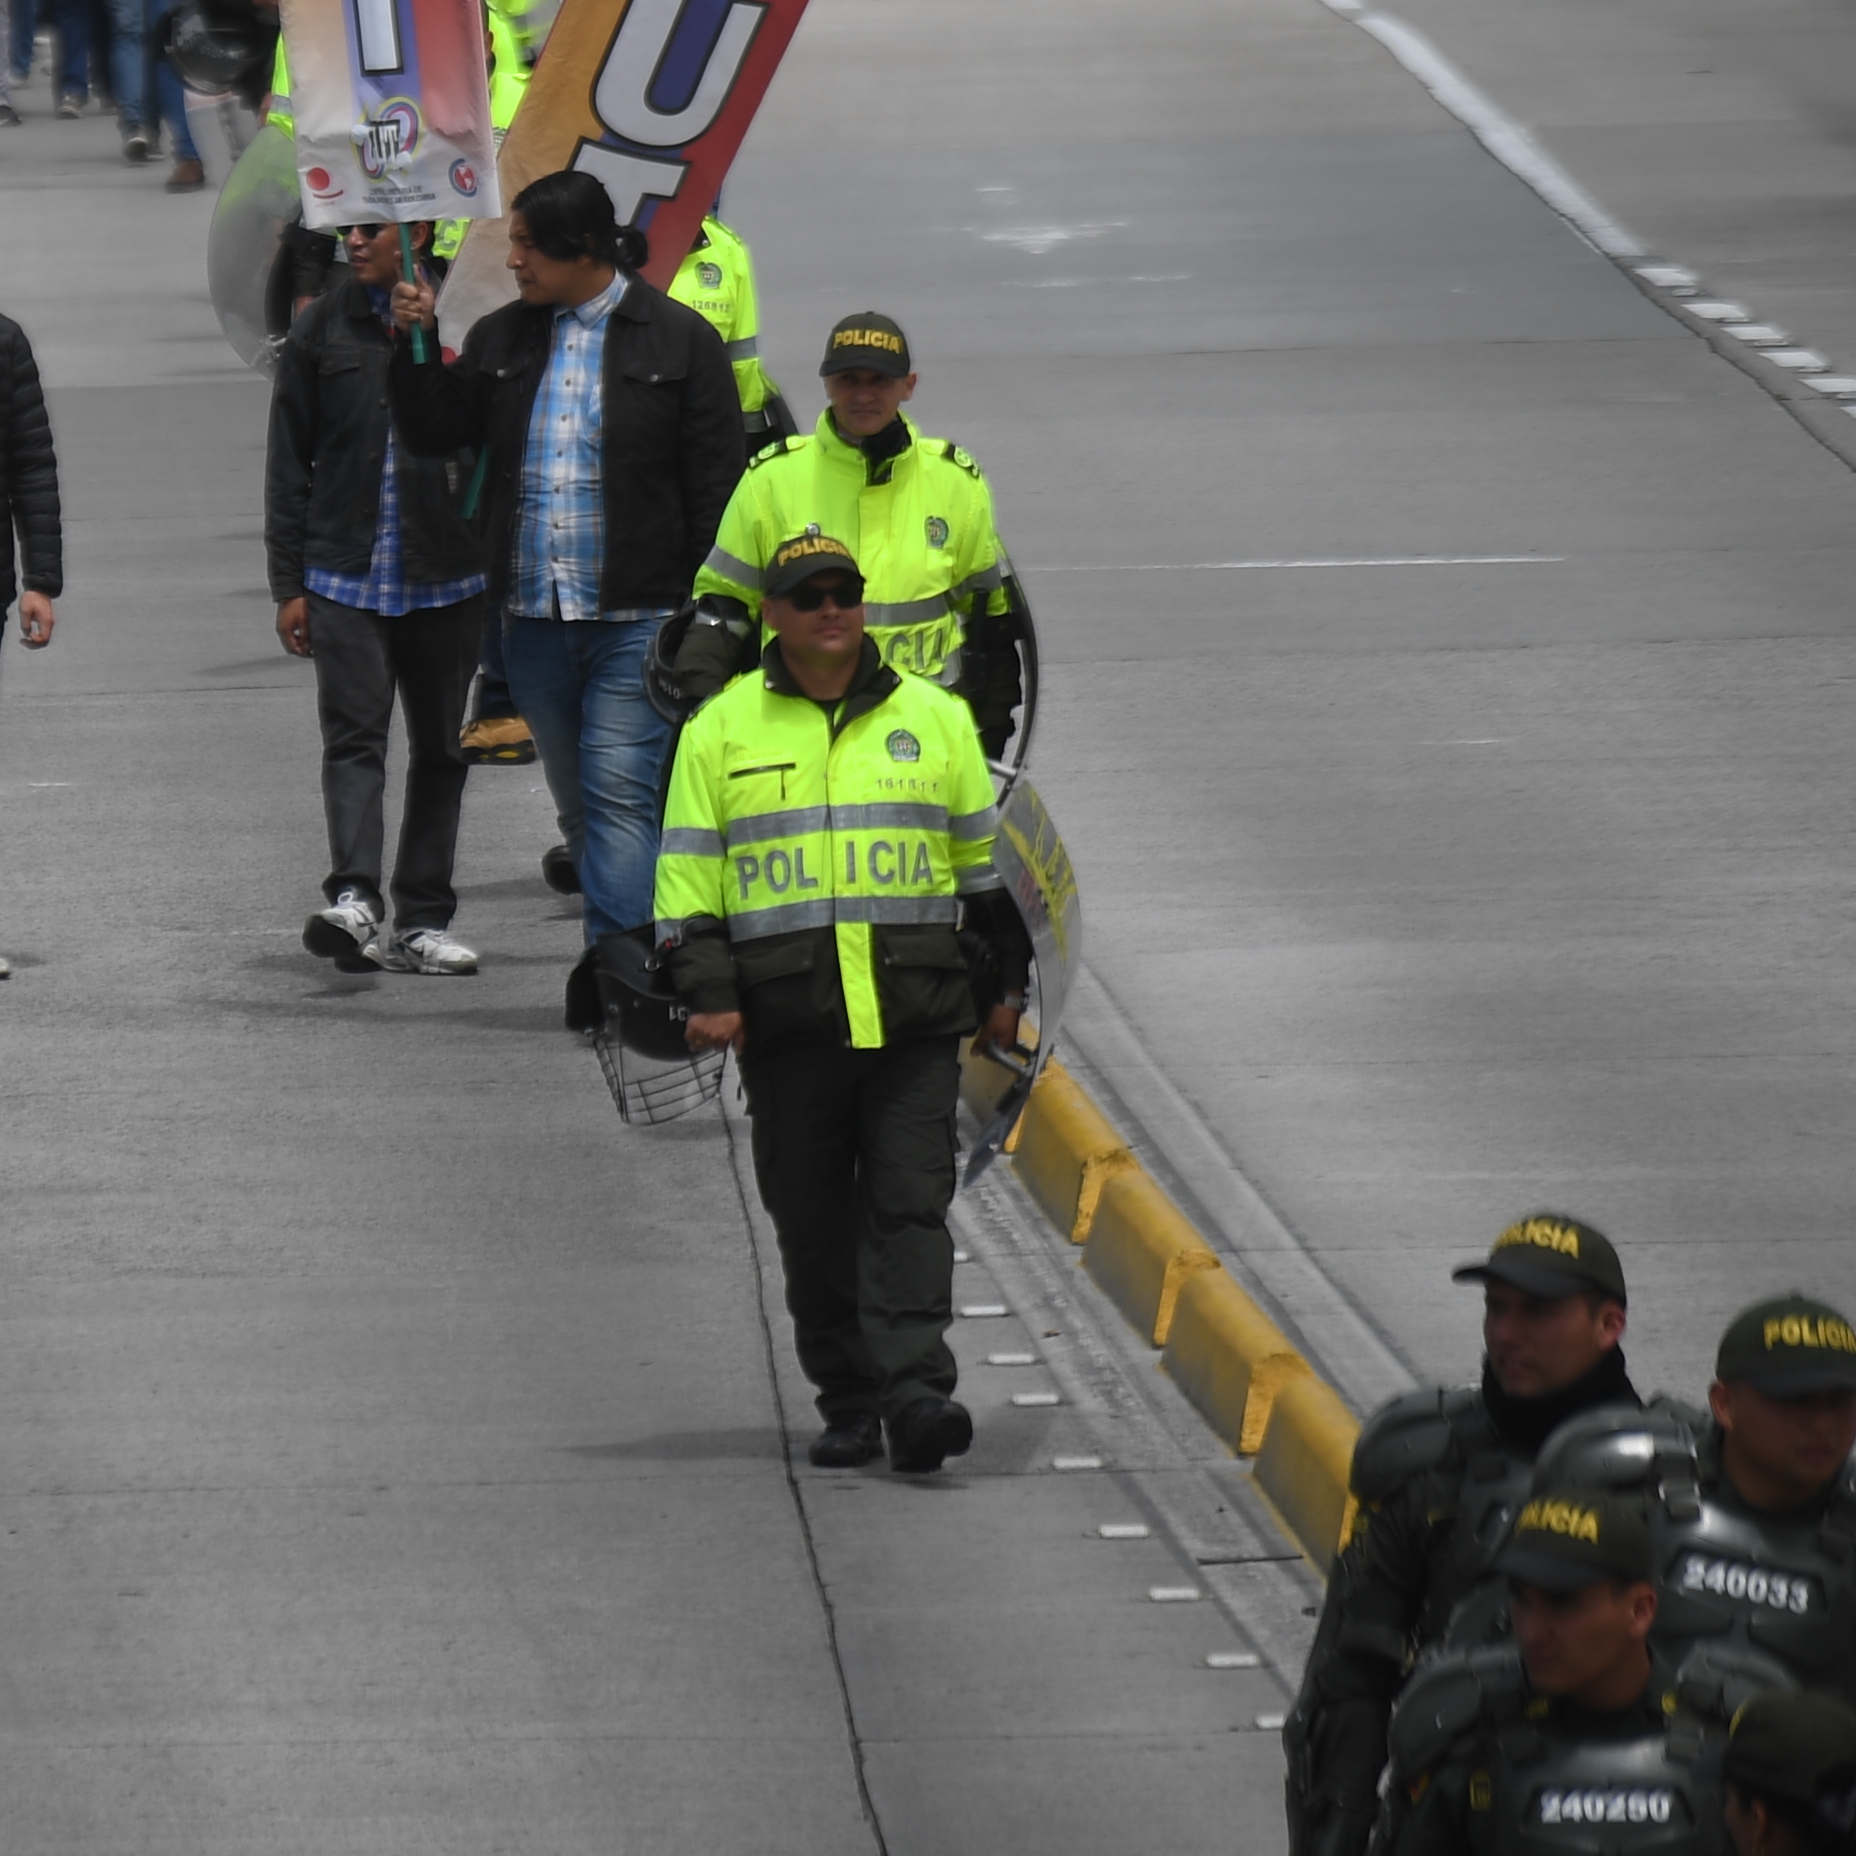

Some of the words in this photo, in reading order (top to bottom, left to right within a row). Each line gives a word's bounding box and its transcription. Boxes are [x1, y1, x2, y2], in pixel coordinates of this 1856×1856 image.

[833, 328, 902, 353] POLICIA
[777, 535, 852, 569] POLICIA
[736, 838, 935, 901] POLICIA
[1682, 1553, 1809, 1615] 240033
